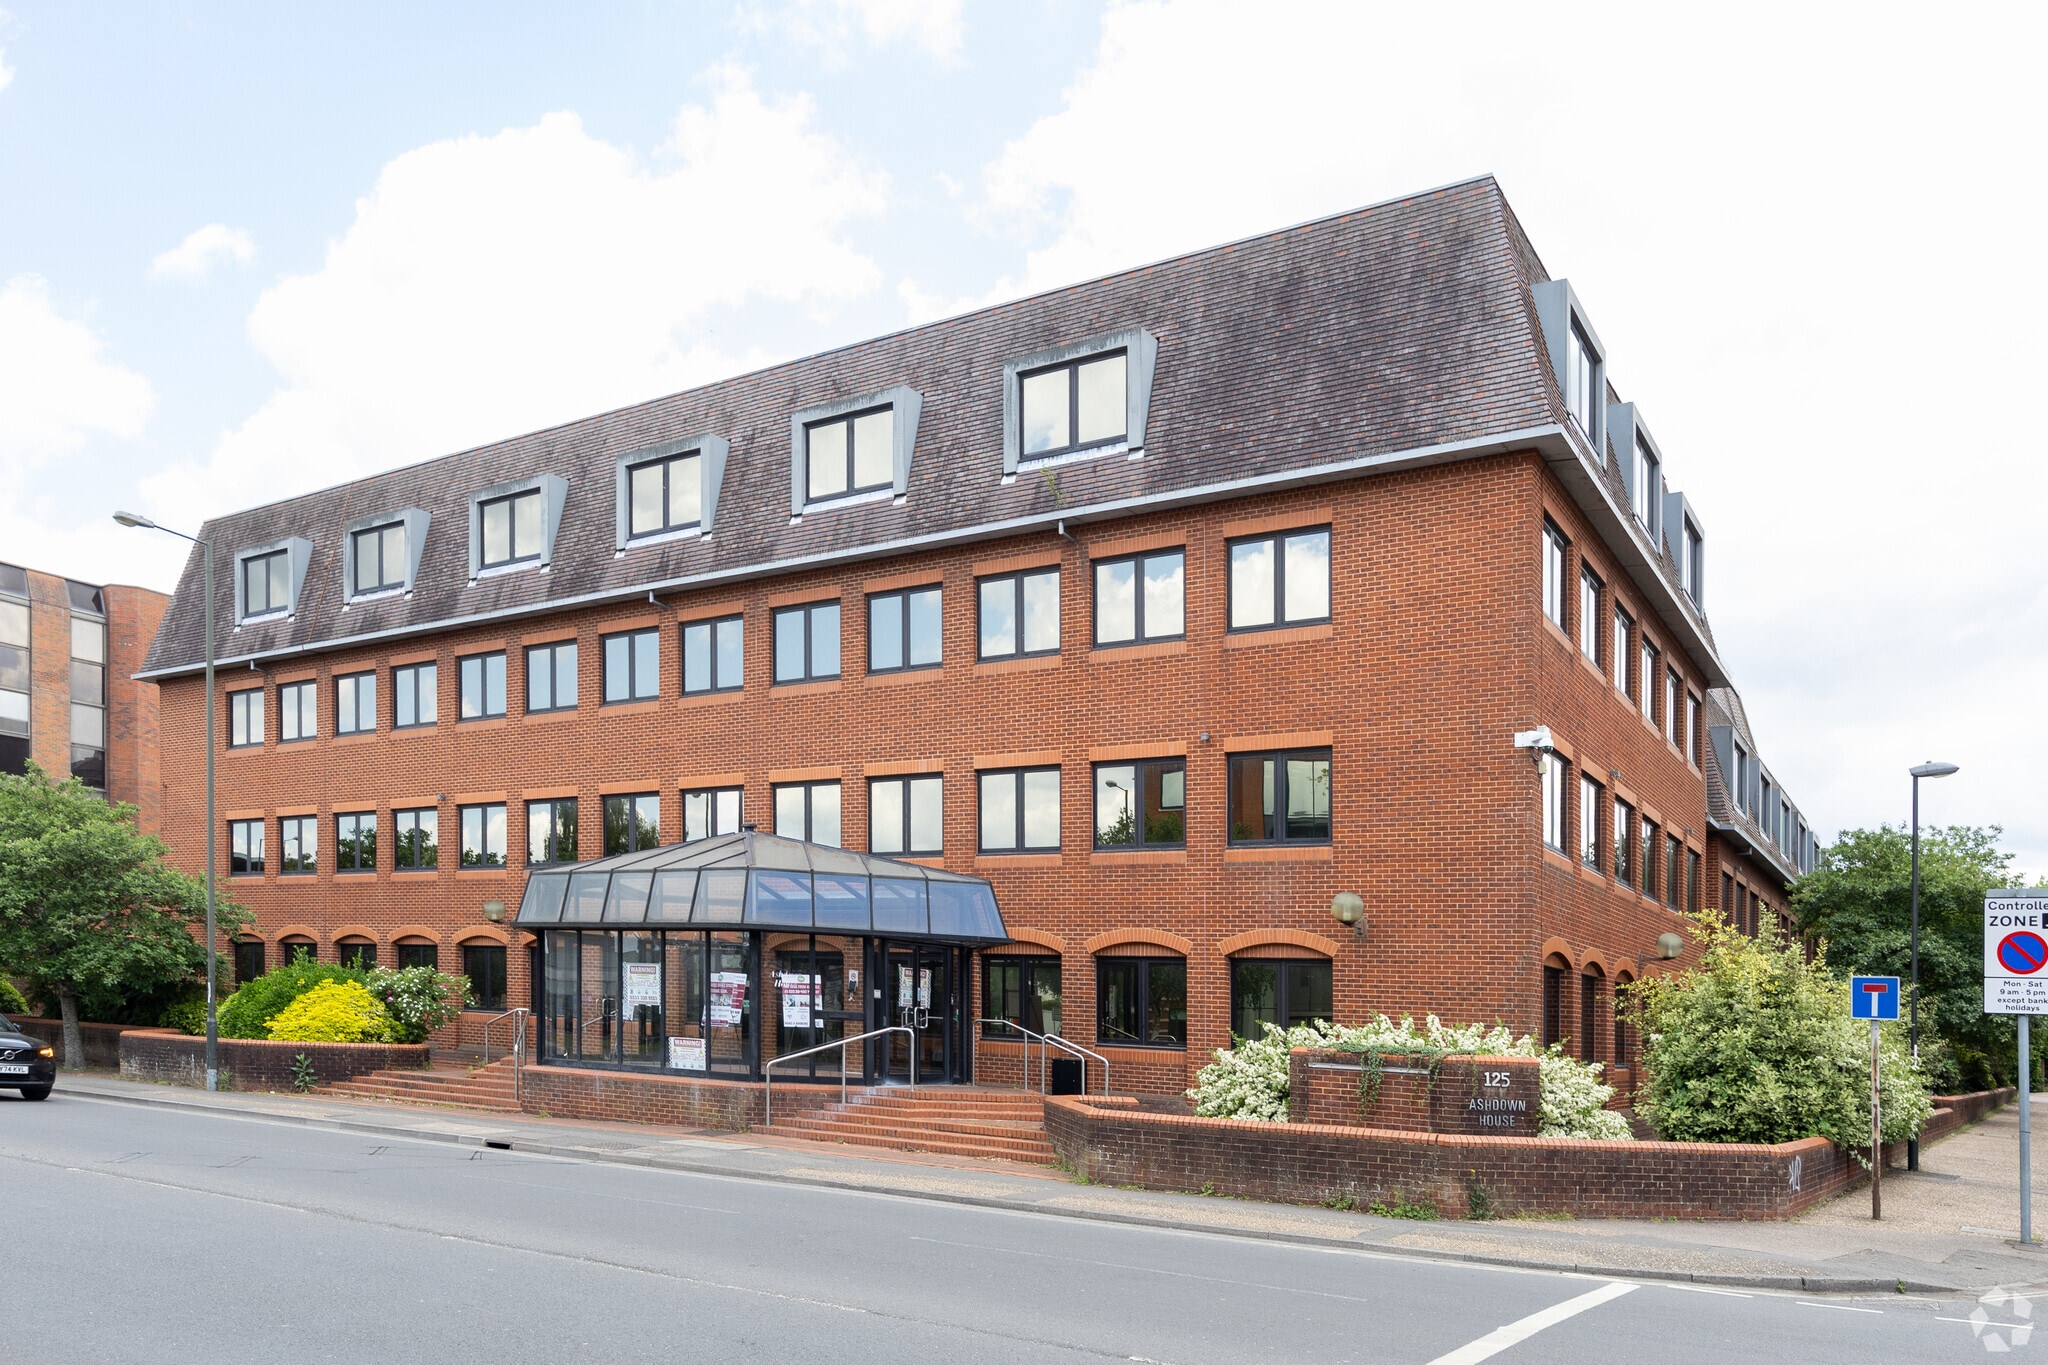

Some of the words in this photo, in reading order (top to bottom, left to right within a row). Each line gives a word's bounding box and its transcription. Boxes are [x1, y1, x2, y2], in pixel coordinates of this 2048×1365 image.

[1988, 901, 2048, 910] Controlle
[1989, 915, 2038, 927] ZONE
[1484, 1072, 1510, 1087] 125
[1469, 1099, 1525, 1111] ASHDOWN
[1480, 1115, 1515, 1127] HOUSE
